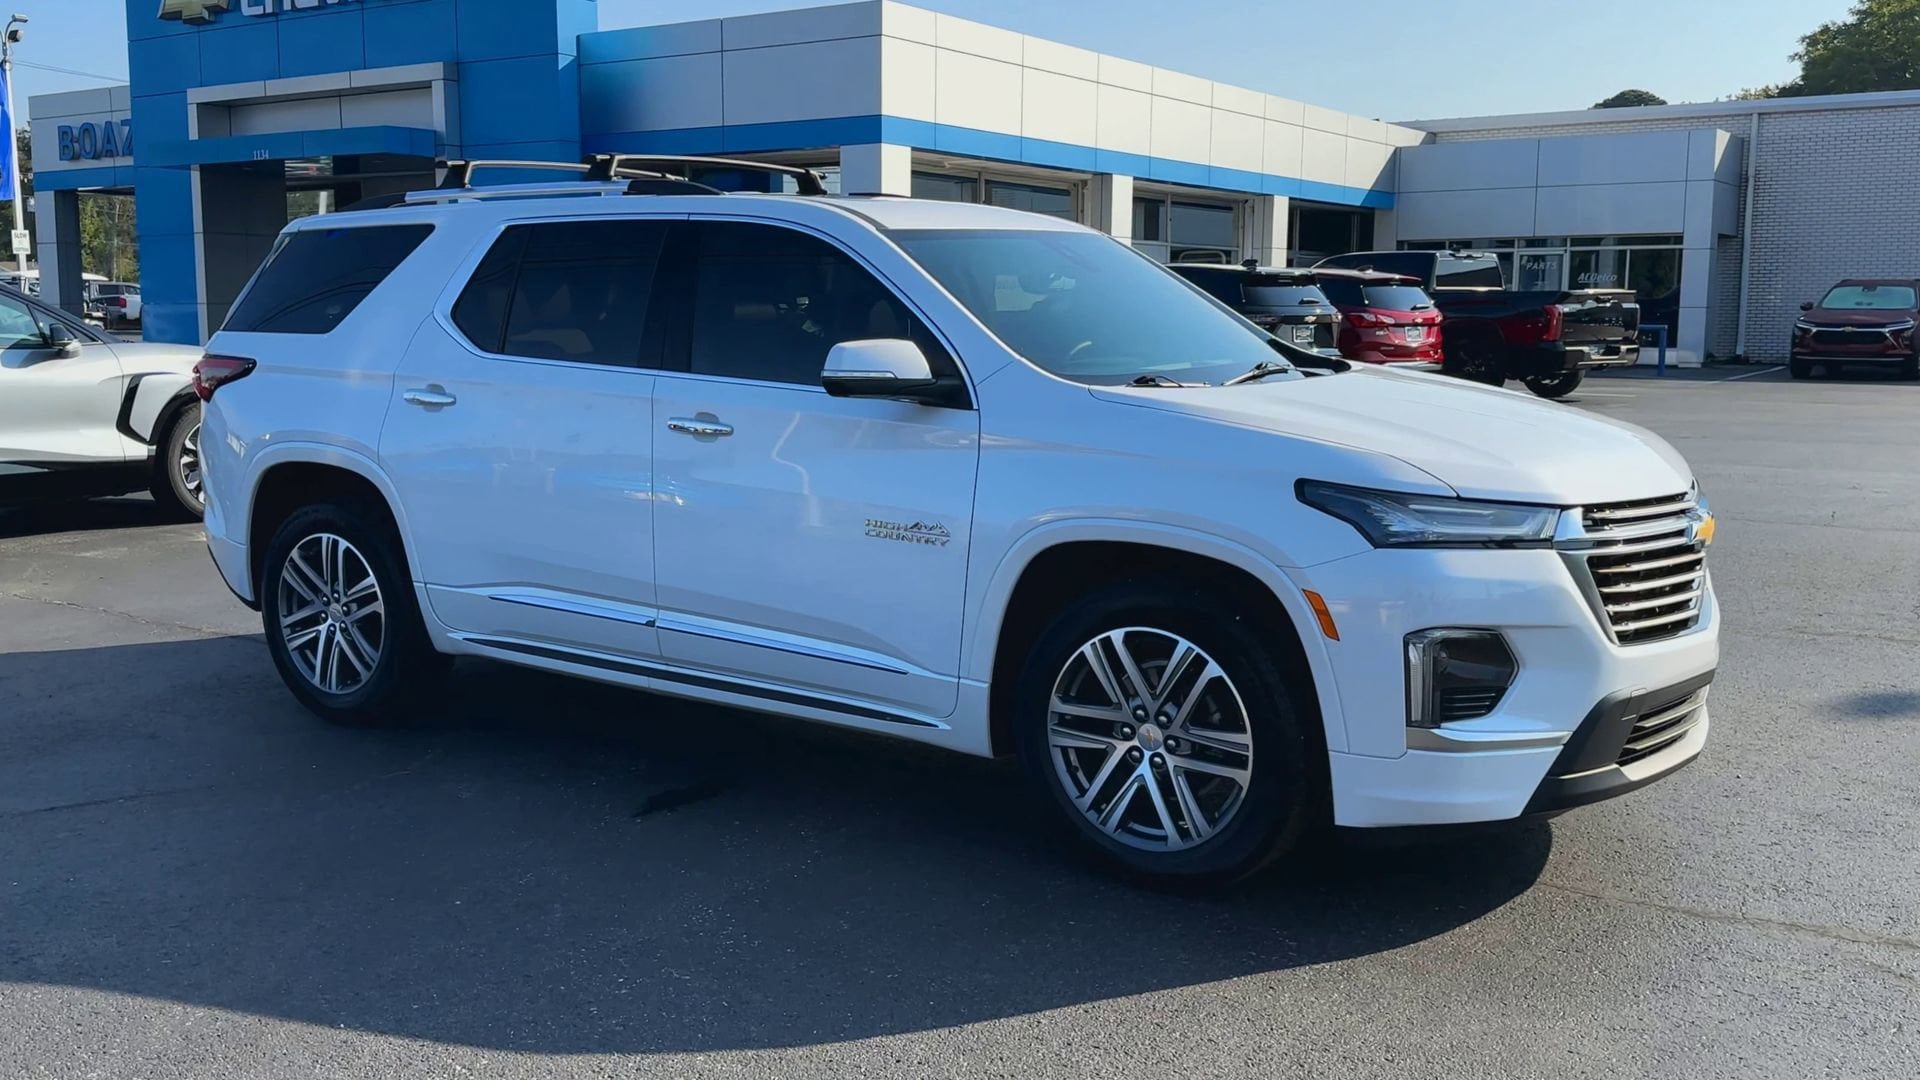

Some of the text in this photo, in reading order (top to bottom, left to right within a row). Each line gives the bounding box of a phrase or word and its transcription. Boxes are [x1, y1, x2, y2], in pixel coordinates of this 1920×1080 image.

[57, 119, 134, 161] BOAZ
[1526, 261, 1558, 270] PARTS
[864, 518, 910, 532] HIGH
[864, 528, 951, 547] COUNTRY
